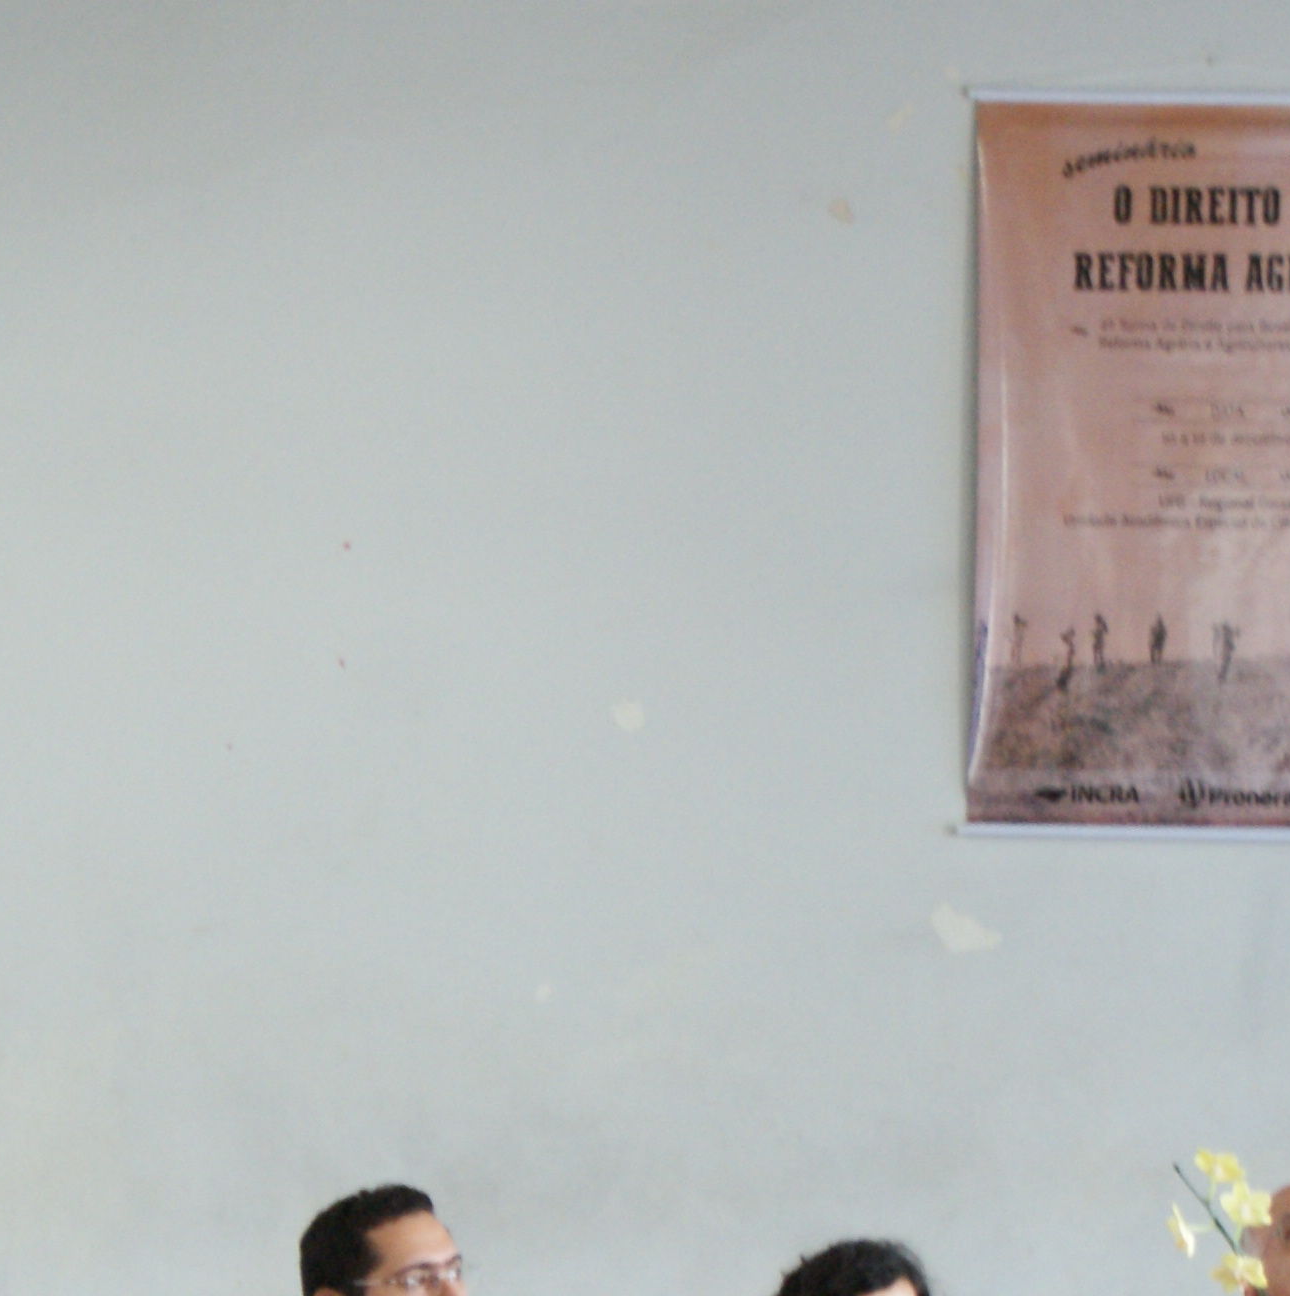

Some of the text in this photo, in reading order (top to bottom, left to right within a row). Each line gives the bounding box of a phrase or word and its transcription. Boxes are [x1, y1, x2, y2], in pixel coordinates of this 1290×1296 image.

[1113, 185, 1133, 226] O
[1149, 185, 1281, 226] DIREITO
[1074, 251, 1230, 293] REFORMA
